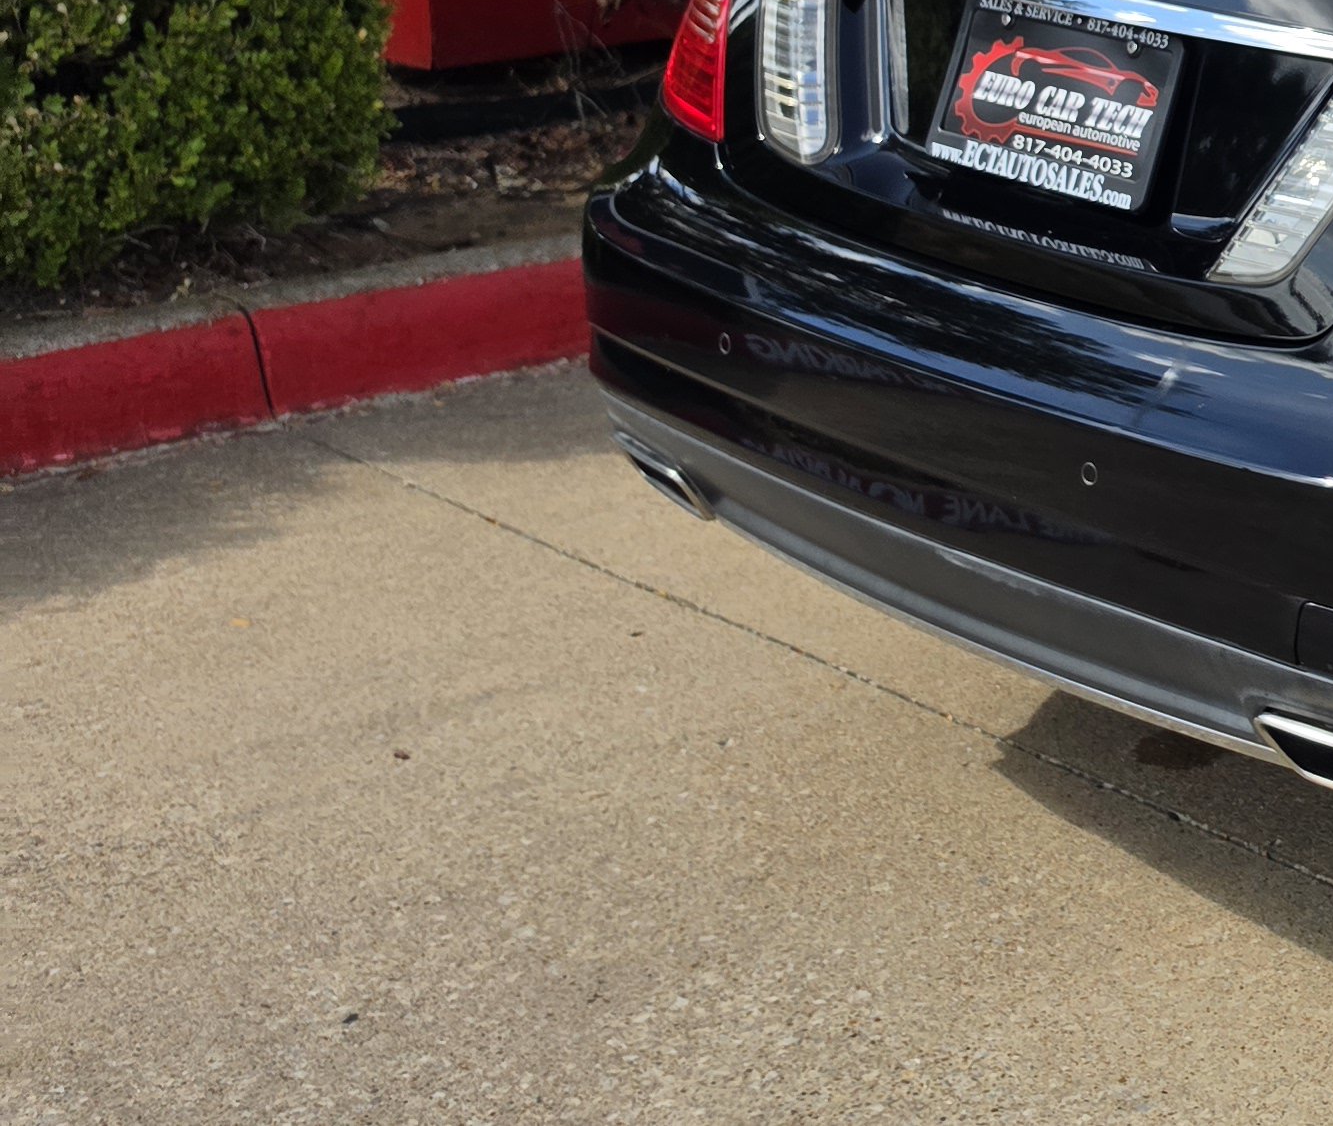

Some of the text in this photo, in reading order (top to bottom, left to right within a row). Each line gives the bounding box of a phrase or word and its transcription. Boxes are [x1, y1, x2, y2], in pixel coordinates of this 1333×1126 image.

[1013, 3, 1023, 15] &
[1025, 4, 1074, 26] SERVICE
[1087, 18, 1169, 49] 817-404-4033
[973, 70, 1154, 138] EURO CAR TECH
[1018, 111, 1141, 152] european automotive
[930, 140, 1132, 210] www.ECTAUTOSALES.com
[1012, 134, 1133, 178] 817-404-4033
